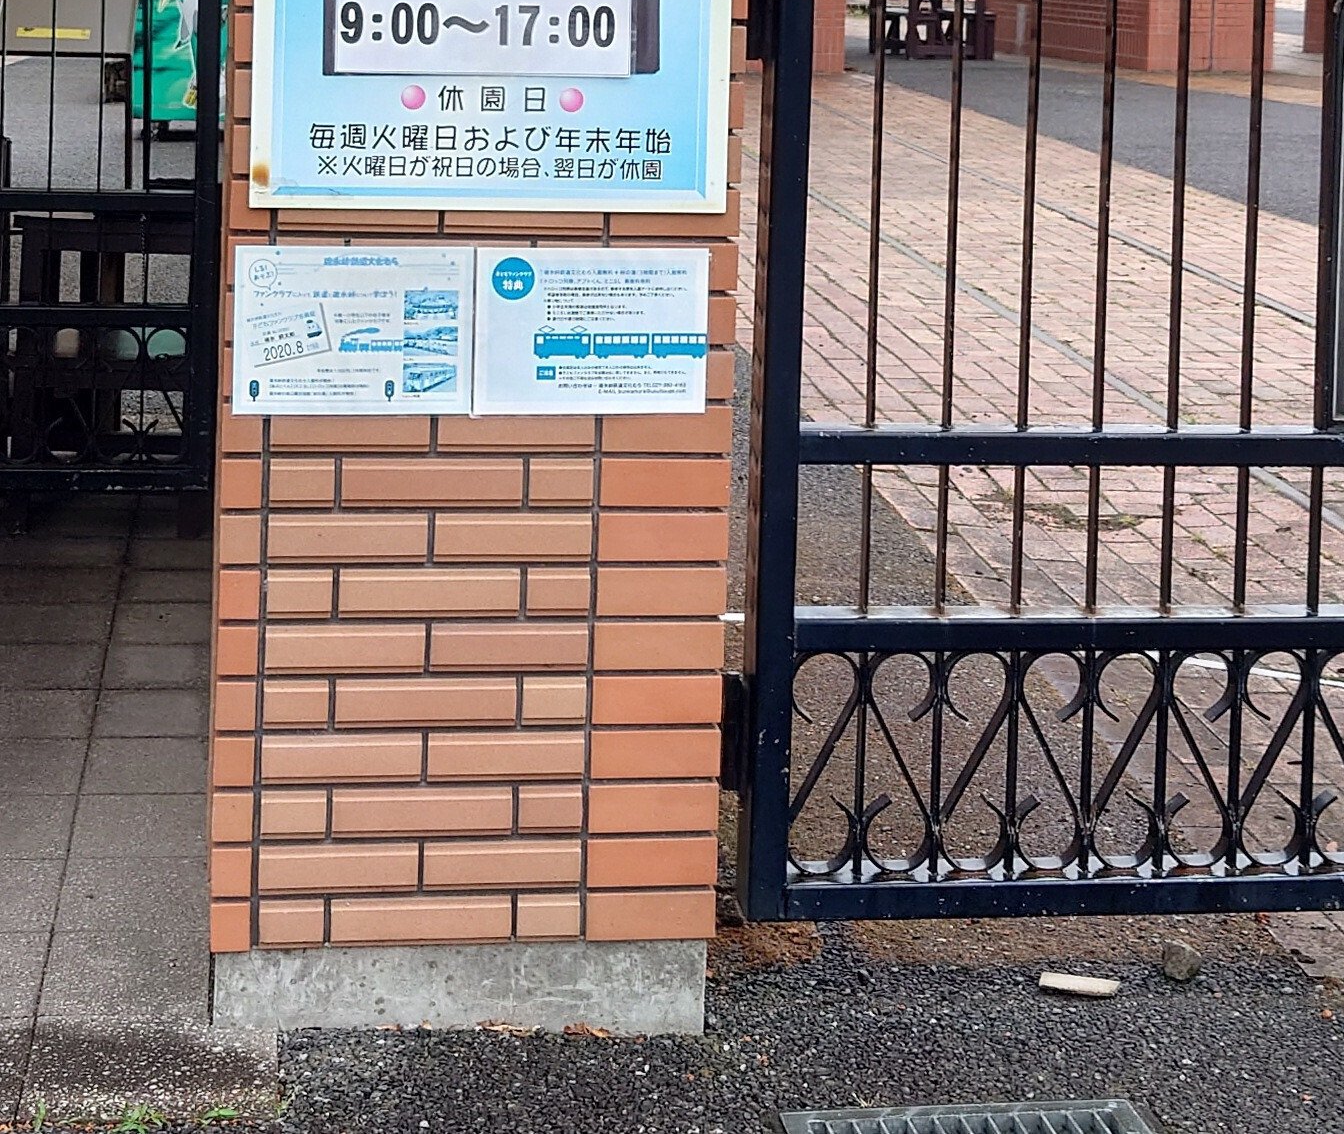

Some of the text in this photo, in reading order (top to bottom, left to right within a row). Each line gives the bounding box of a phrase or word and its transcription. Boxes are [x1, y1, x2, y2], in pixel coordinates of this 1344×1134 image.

[437, 84, 547, 114] 休園日
[308, 122, 672, 155] 毎週火曜日および年末年始
[316, 155, 663, 181] ※火曜日が祝日の場合、翌日が休園
[263, 340, 304, 362] 2020.8
